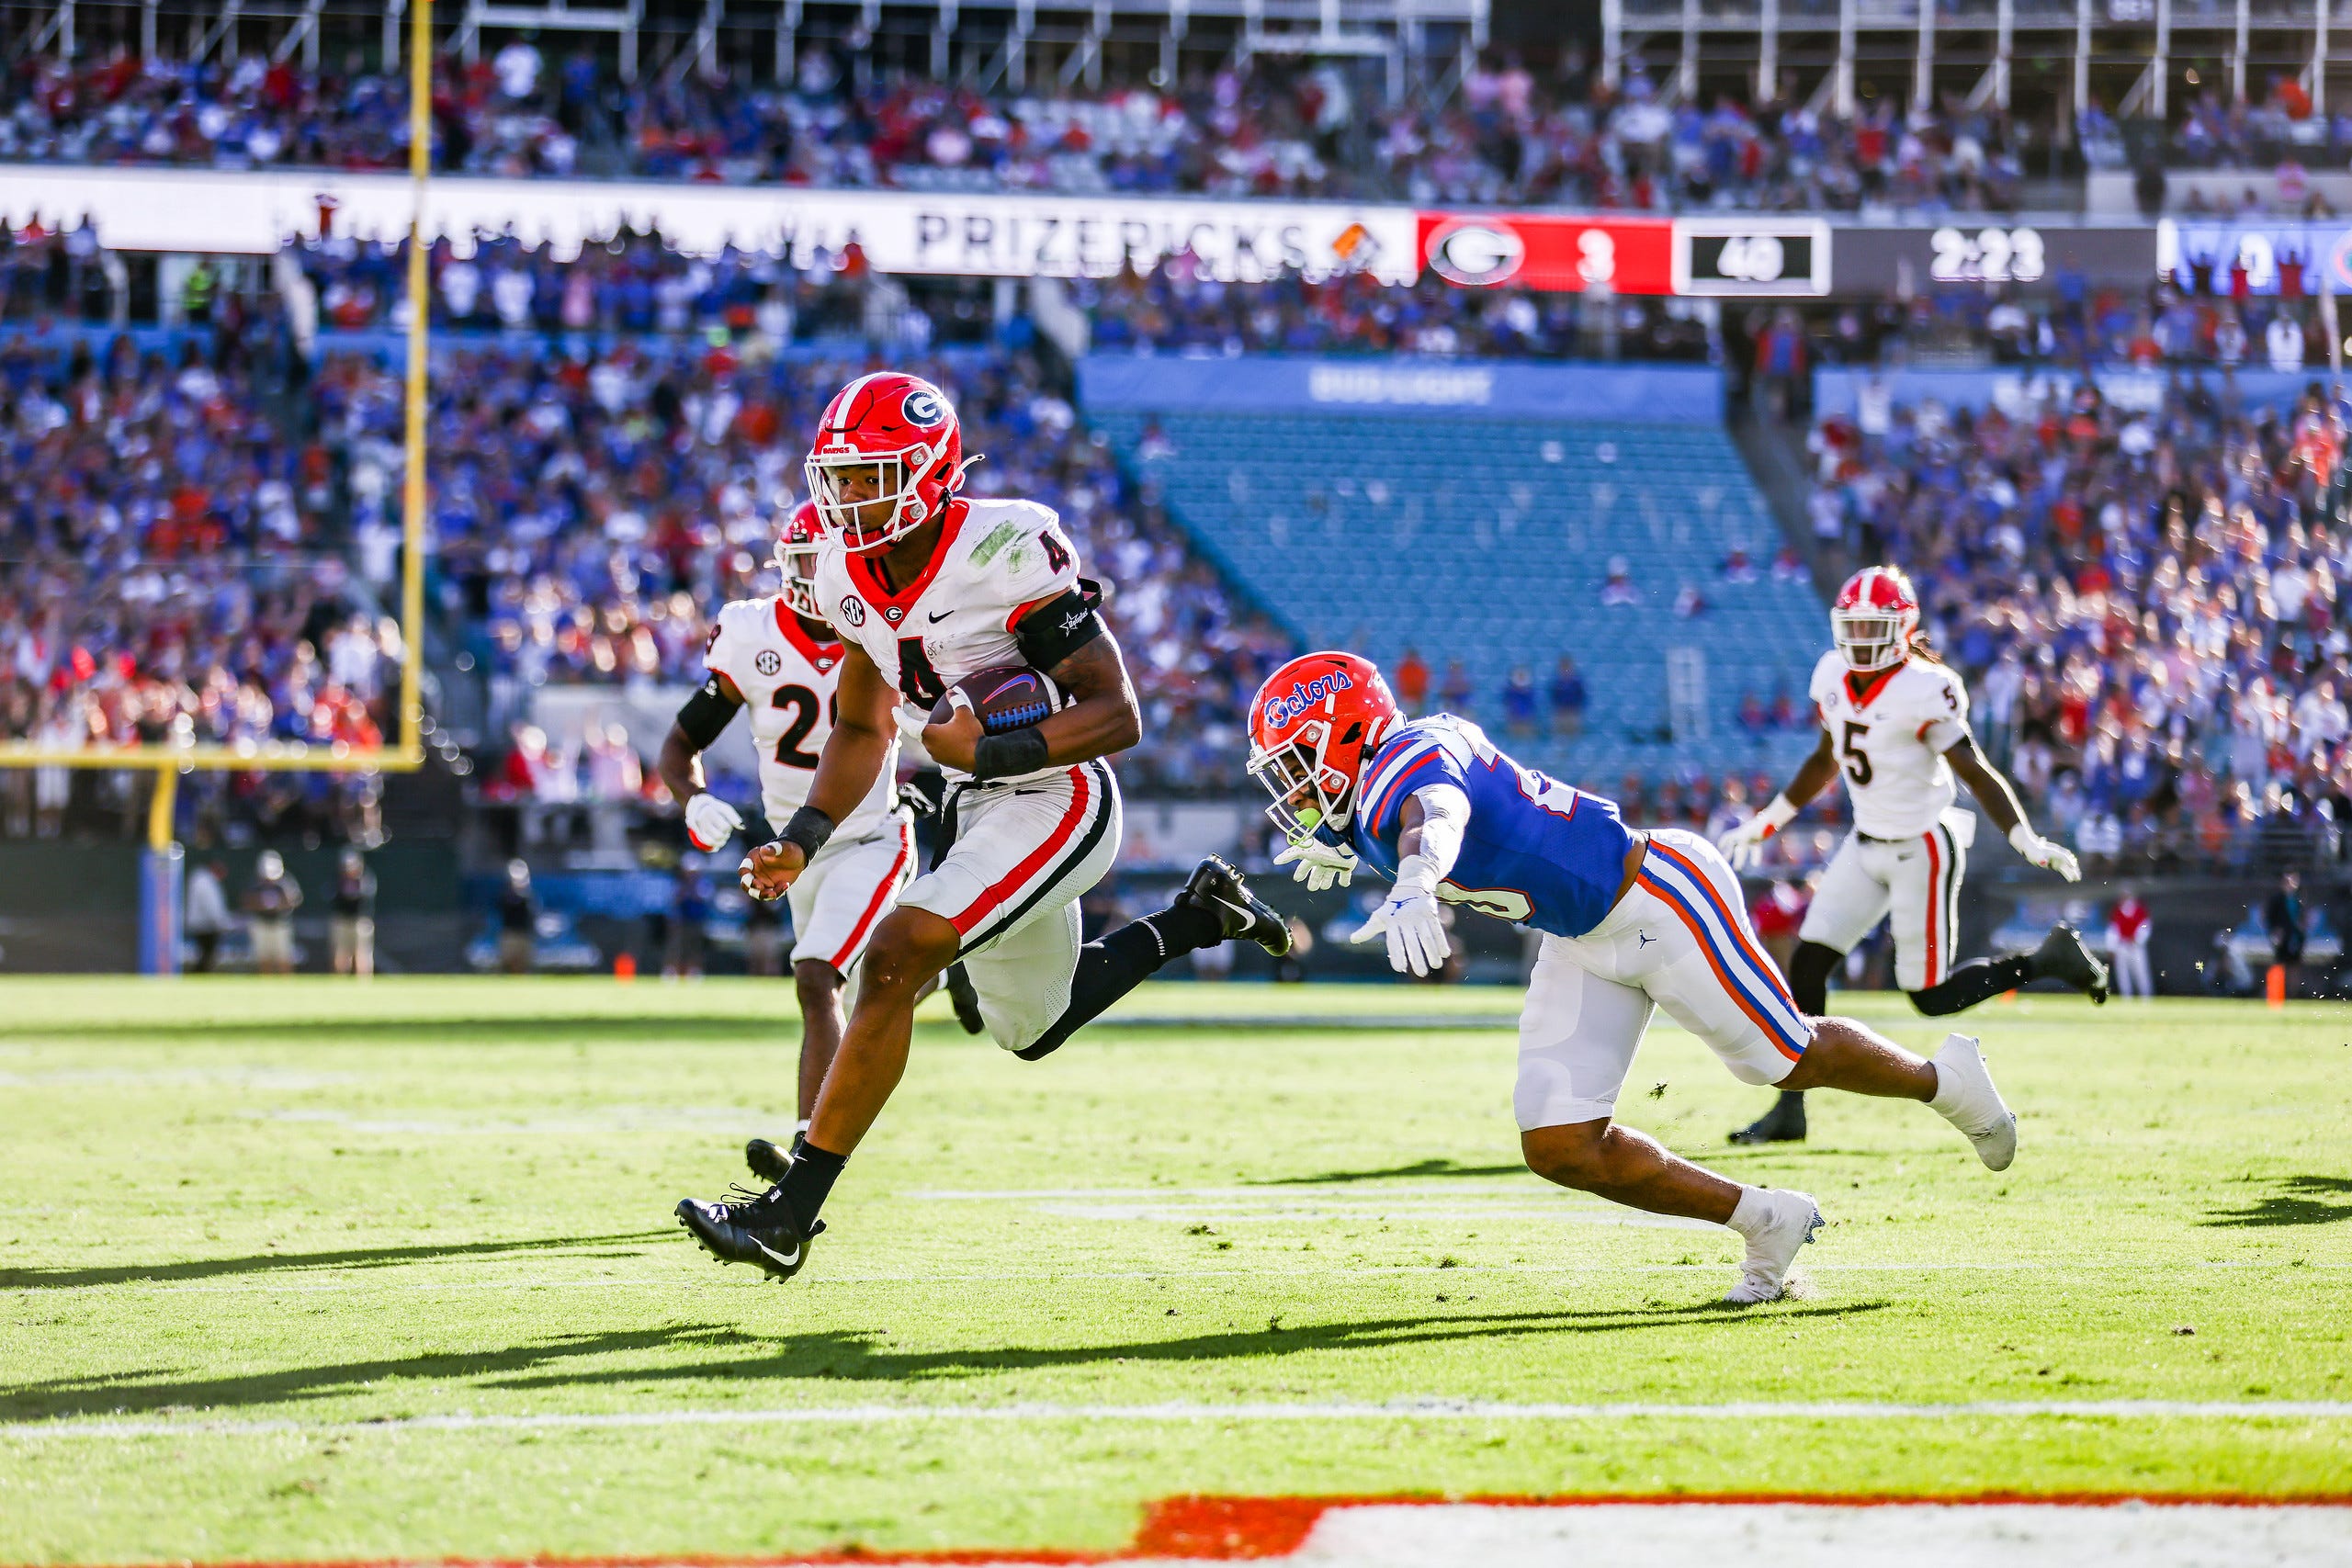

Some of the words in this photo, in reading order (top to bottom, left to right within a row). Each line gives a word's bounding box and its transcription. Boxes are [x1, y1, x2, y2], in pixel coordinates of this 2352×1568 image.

[1038, 530, 1072, 575] 4
[841, 596, 865, 626] SEC
[898, 636, 950, 712] 4
[1265, 671, 1352, 728] Gators
[1942, 685, 1958, 710] 5
[772, 683, 837, 772] 2
[1844, 720, 1872, 786] 5
